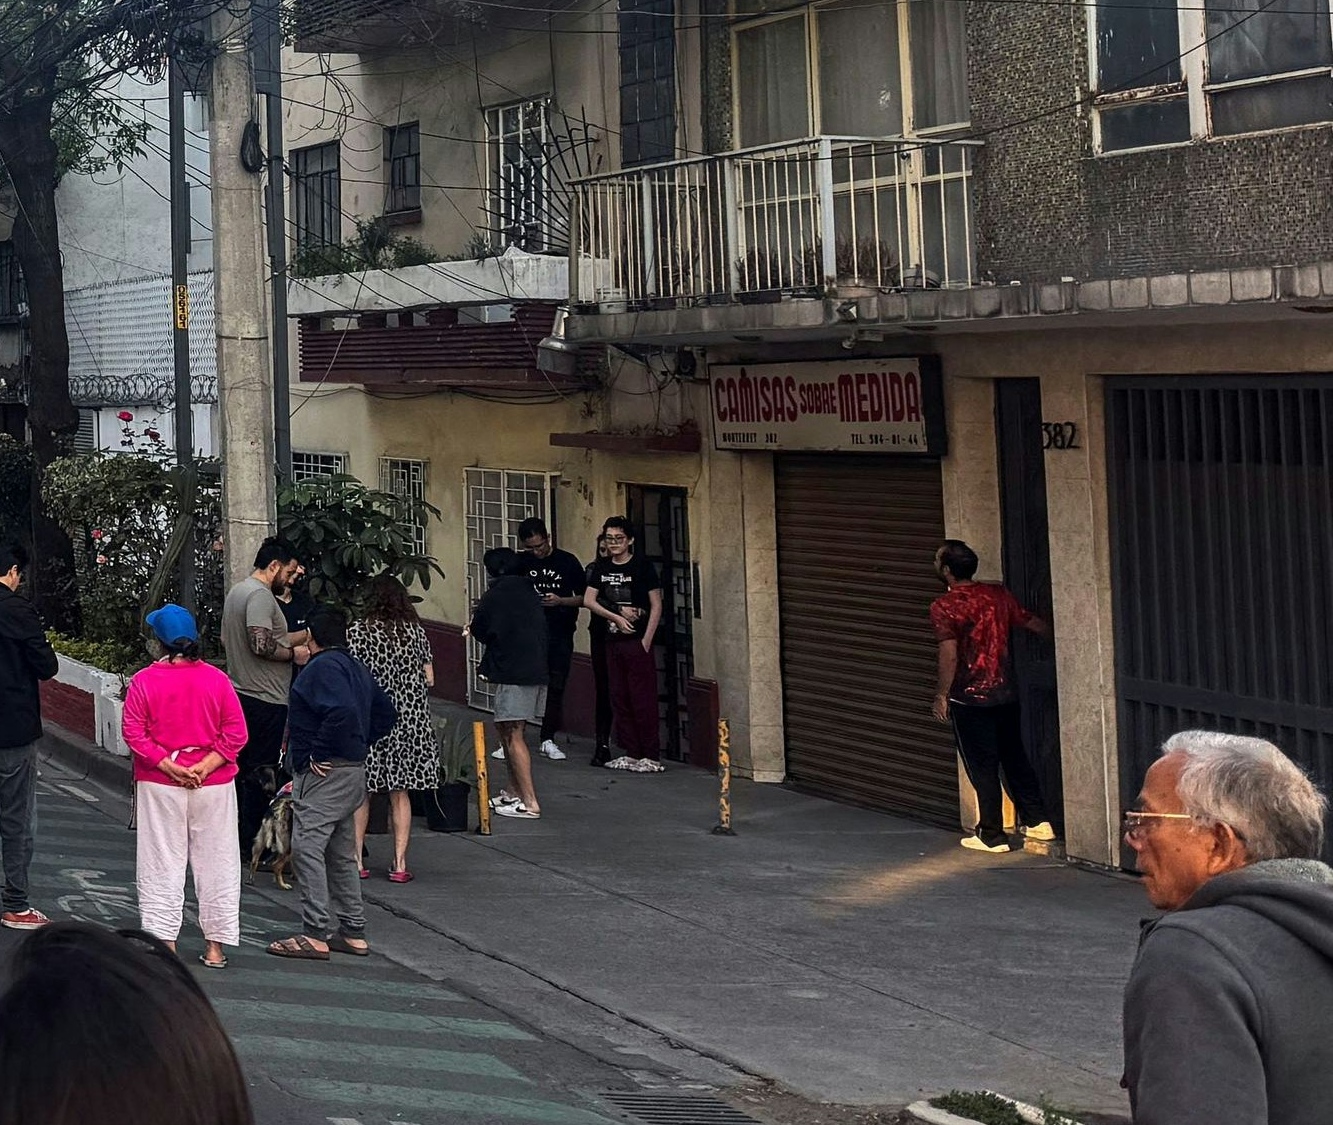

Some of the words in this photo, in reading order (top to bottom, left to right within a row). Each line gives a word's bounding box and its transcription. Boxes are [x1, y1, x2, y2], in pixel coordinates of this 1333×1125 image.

[715, 375, 798, 423] CAMISAS
[799, 382, 837, 414] SOBRE
[837, 371, 921, 423] MEDIDA
[1042, 422, 1080, 449] 382
